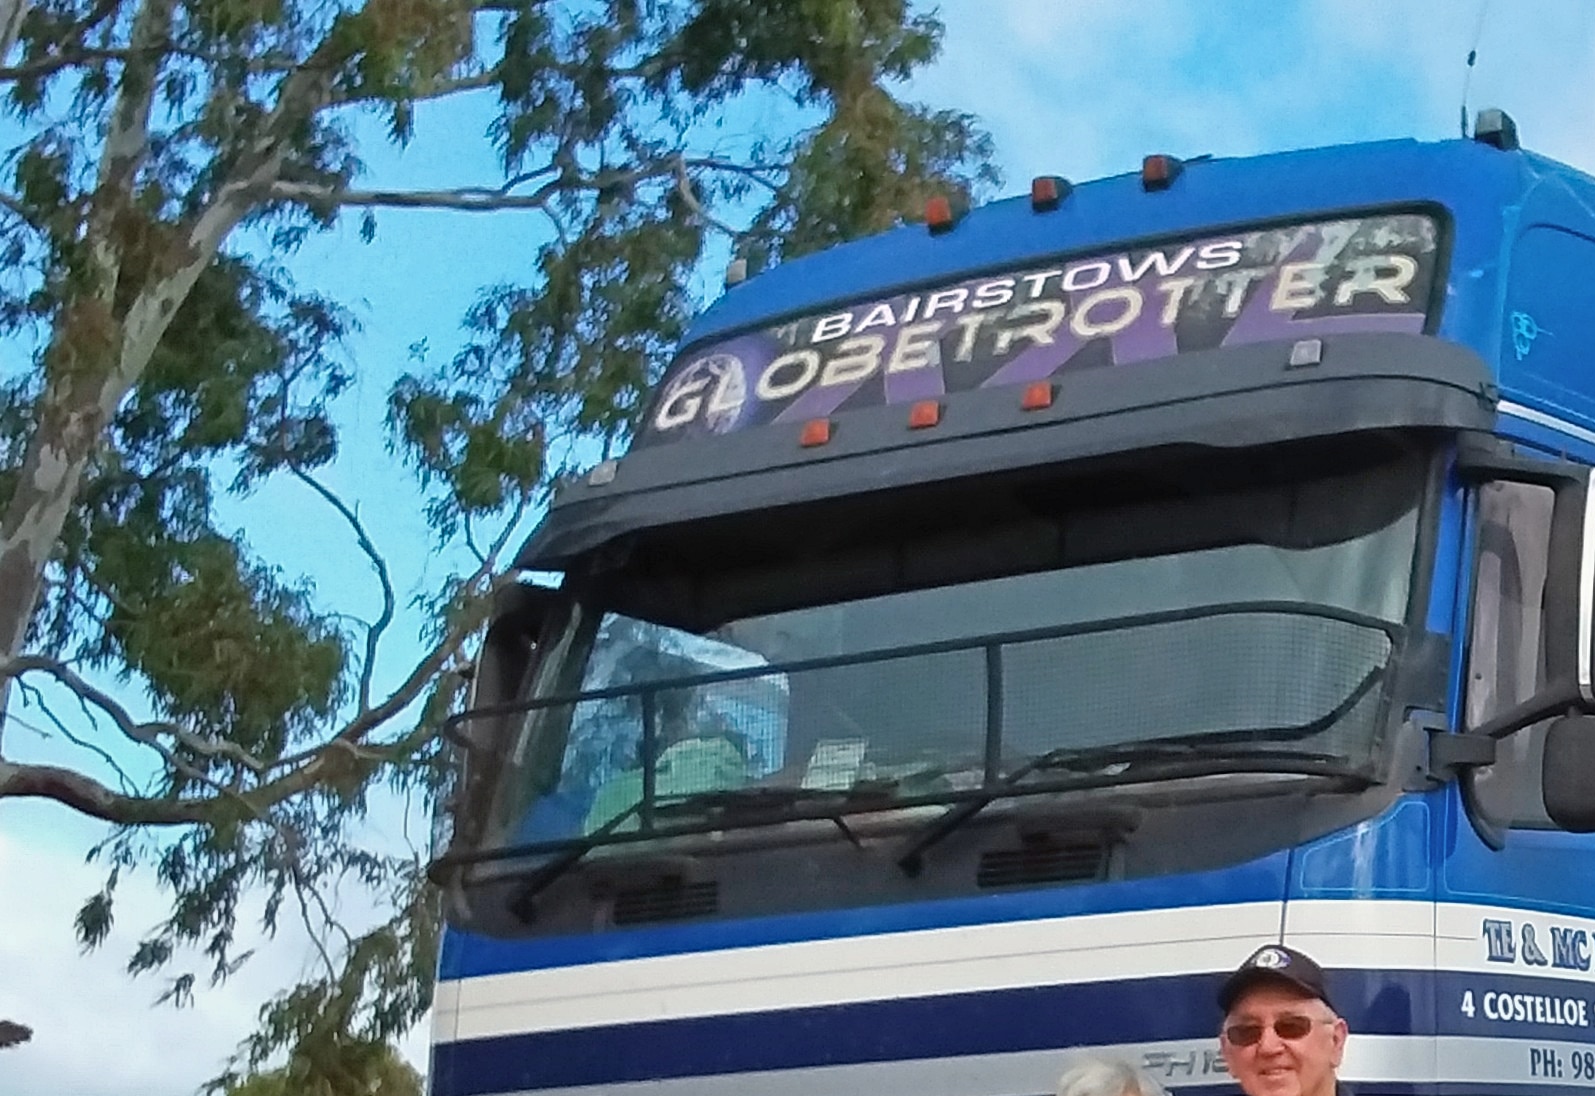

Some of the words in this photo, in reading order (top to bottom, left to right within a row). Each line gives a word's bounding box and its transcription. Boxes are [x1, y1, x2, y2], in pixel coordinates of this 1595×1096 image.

[812, 240, 1243, 342] BAIRSTOWS
[653, 256, 1419, 431] GLOBETROTTER
[1520, 924, 1547, 965] &
[1551, 927, 1591, 972] MC
[1461, 991, 1476, 1018] 4
[1484, 995, 1589, 1028] COSTELLOE
[1530, 1048, 1563, 1079] PH:
[1572, 1053, 1595, 1081] 98
